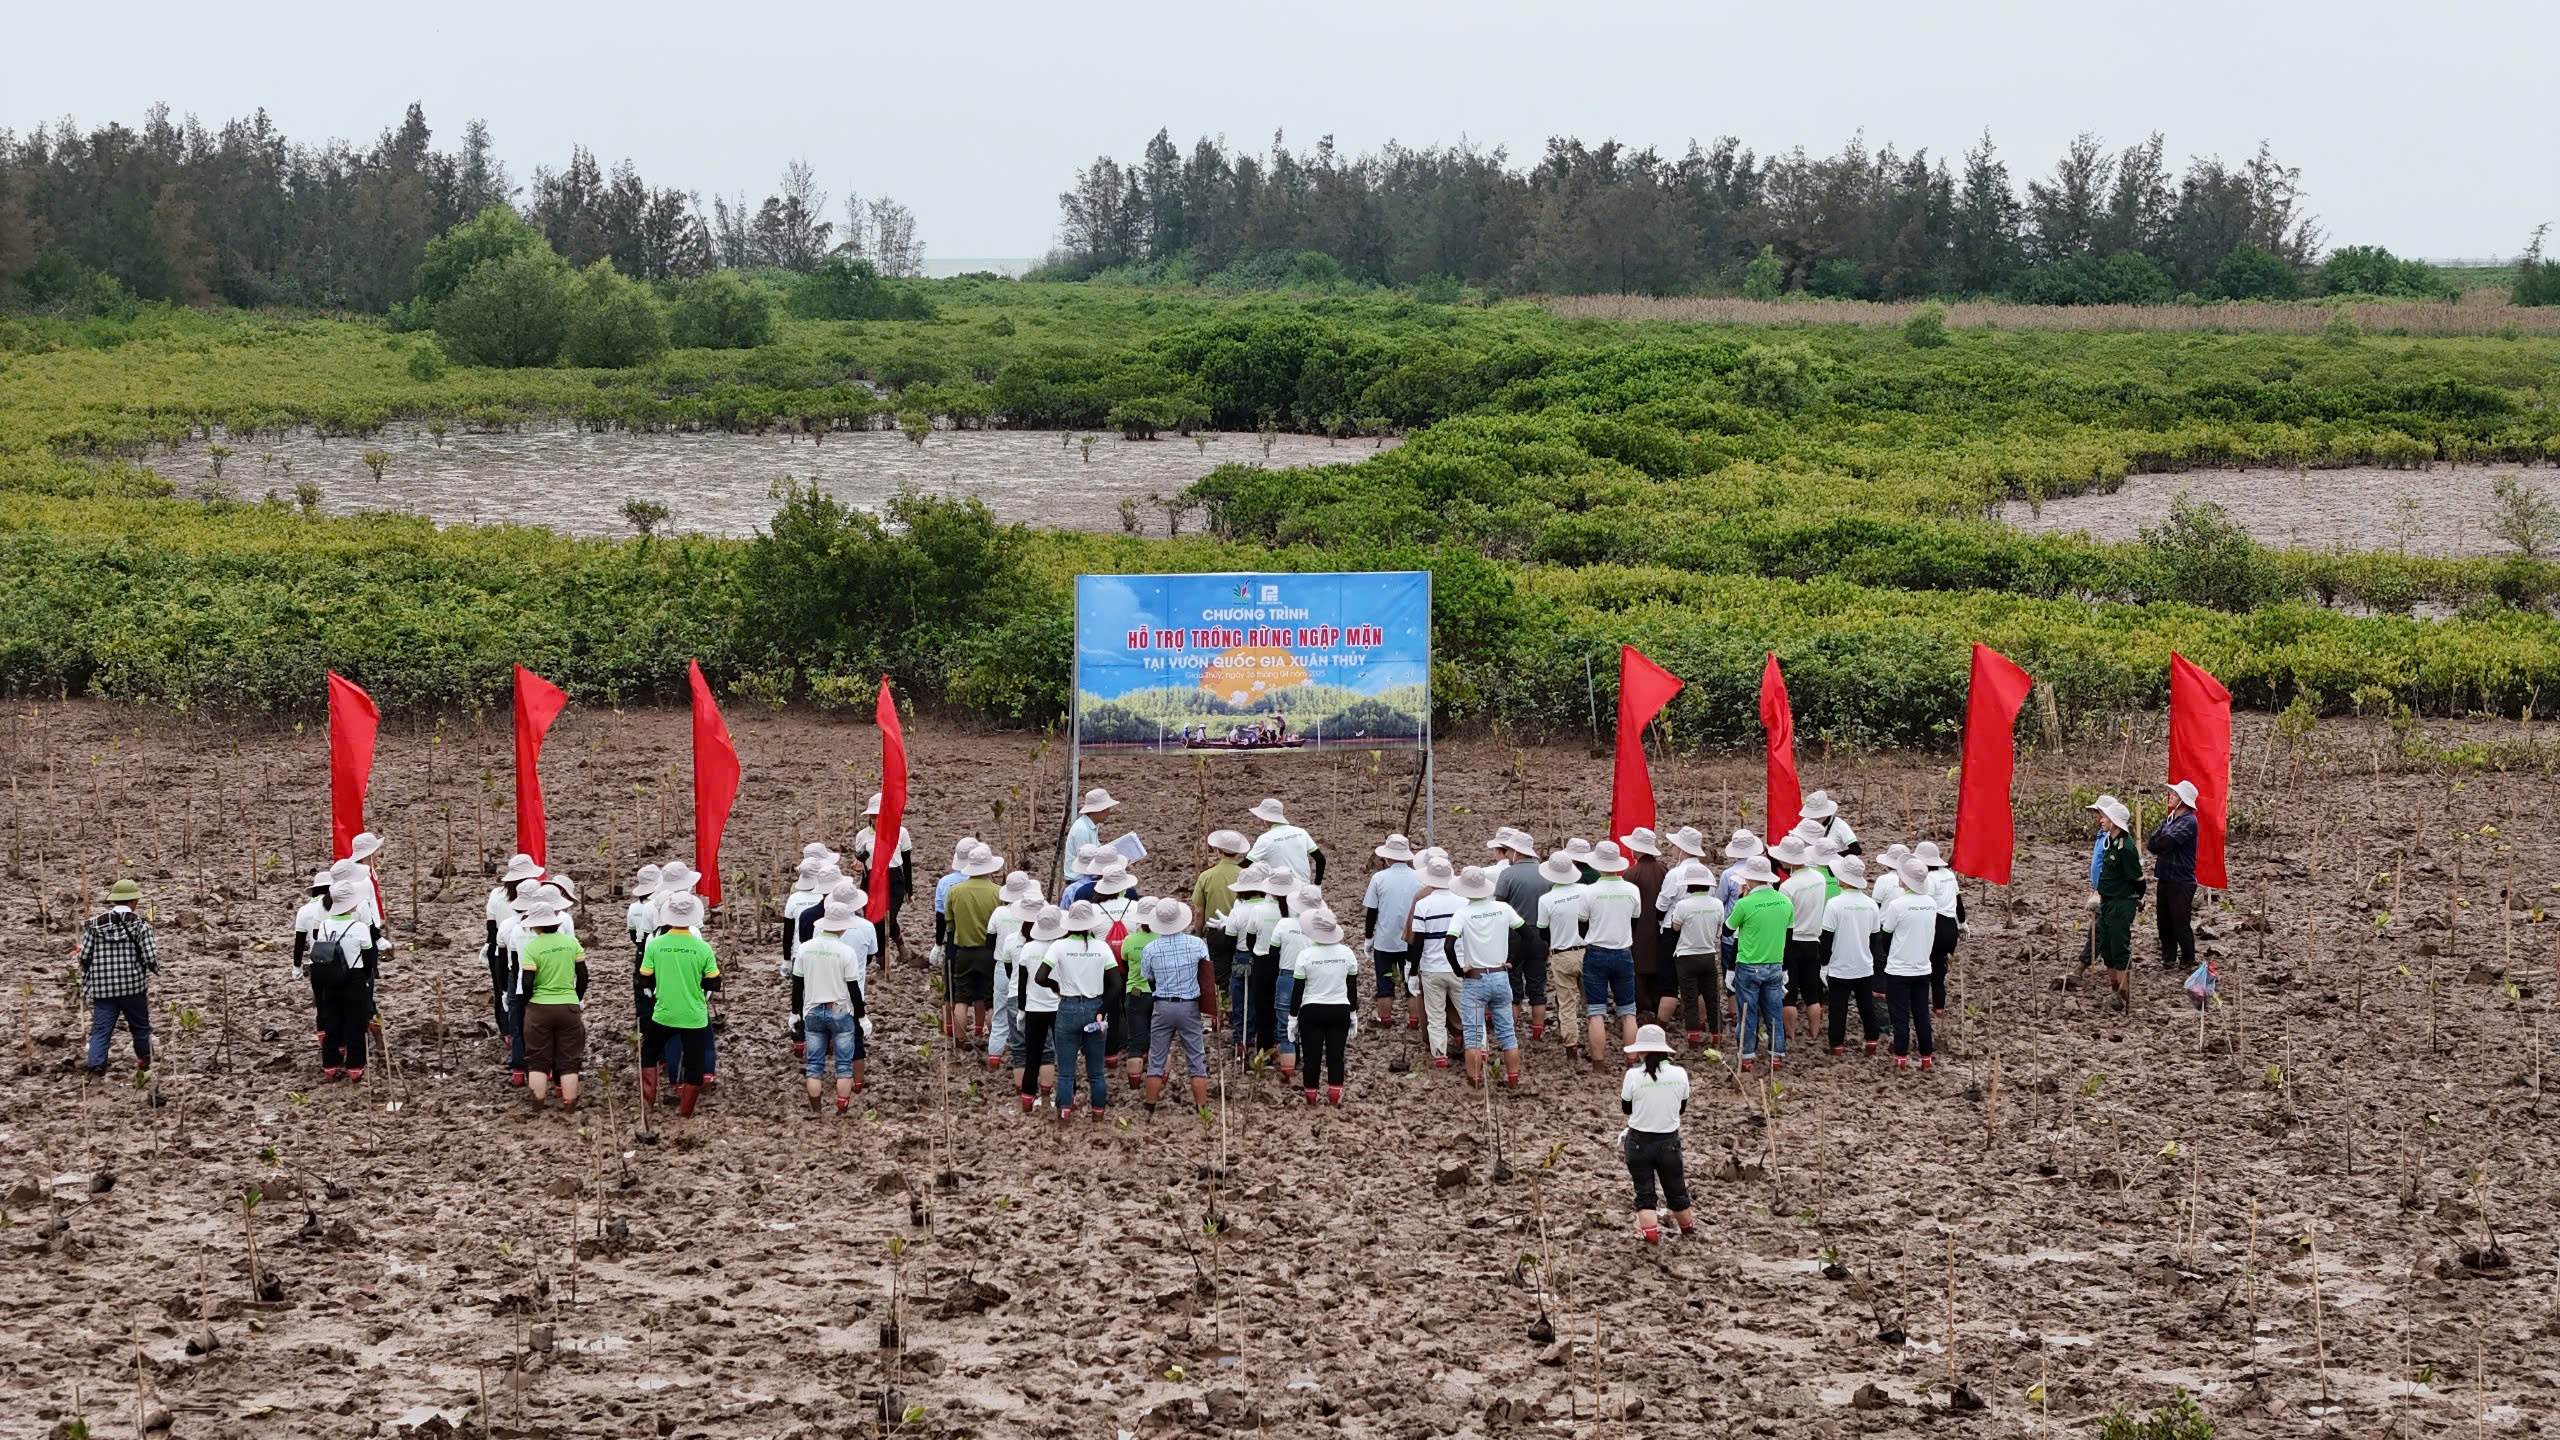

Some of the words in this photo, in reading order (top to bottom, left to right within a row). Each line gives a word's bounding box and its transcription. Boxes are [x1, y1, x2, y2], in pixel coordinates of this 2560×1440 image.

[1202, 607, 1265, 621] CHƯƠNG
[1269, 605, 1309, 620] TRÌNH
[1127, 625, 1148, 649] HỖ
[1155, 628, 1185, 652] TRỢ
[1191, 625, 1242, 648] TRỒNG
[1248, 624, 1292, 648] RỪNG
[1298, 624, 1340, 650] NGẬP
[1346, 624, 1382, 650] MẶN
[1143, 657, 1164, 672] TẠI
[1168, 654, 1209, 669] VƯỜN
[1213, 652, 1256, 668] QUỐC
[1259, 656, 1286, 667] GIA
[1289, 653, 1329, 667] XUÂN
[1332, 651, 1366, 666] THỦY
